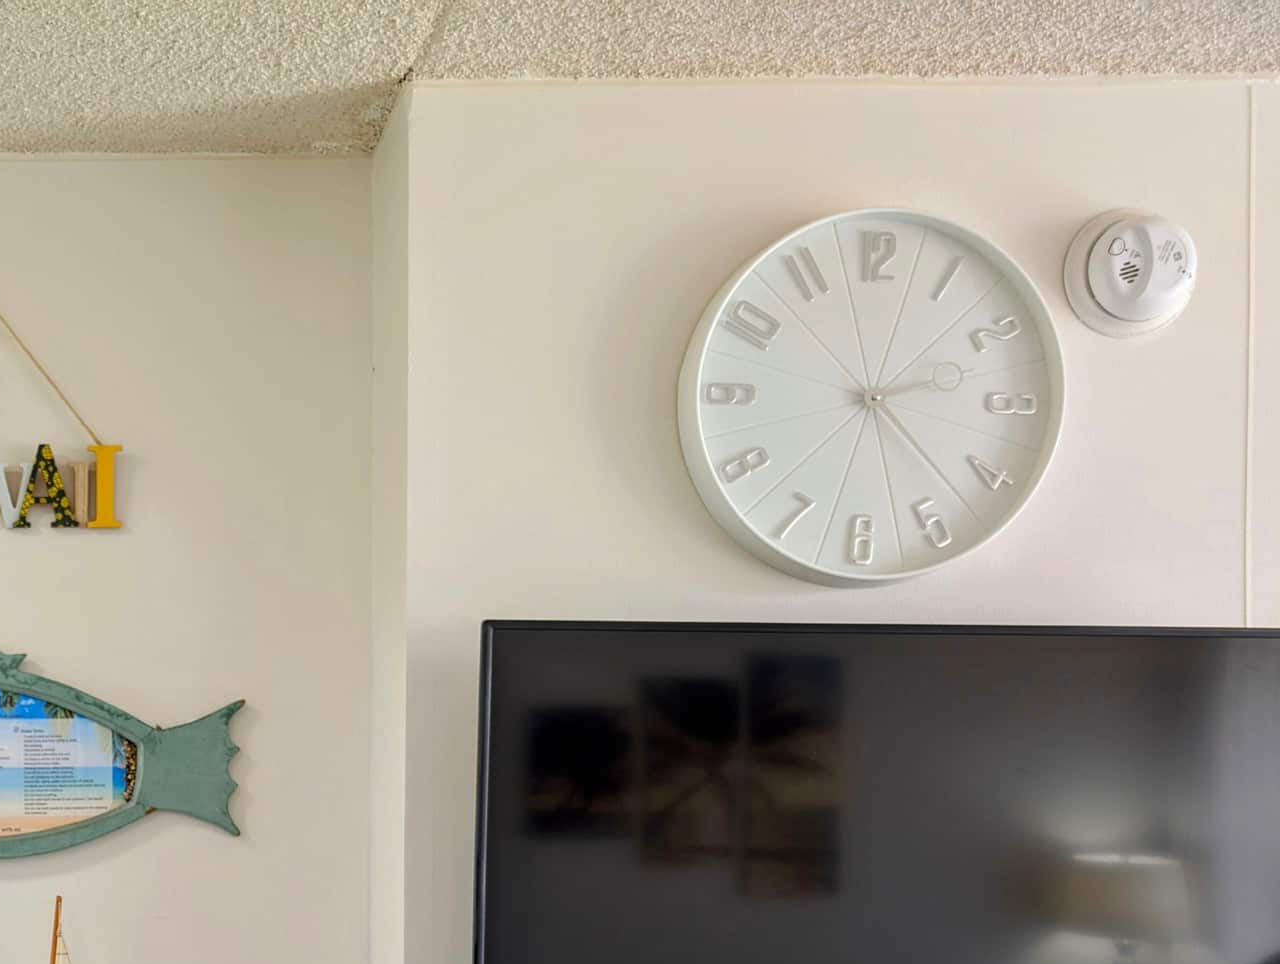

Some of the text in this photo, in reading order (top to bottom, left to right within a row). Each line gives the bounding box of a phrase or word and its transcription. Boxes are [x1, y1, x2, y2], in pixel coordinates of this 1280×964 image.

[785, 246, 830, 302] 11
[859, 230, 898, 283] 12
[931, 255, 965, 302] 1
[722, 299, 781, 352] 10
[970, 316, 1022, 352] 2
[706, 382, 756, 404] 9
[985, 390, 1037, 415] 3
[719, 447, 770, 484] 8
[967, 454, 1014, 491] 4
[776, 492, 817, 539] 7
[910, 496, 953, 548] 5
[848, 513, 874, 566] 6
